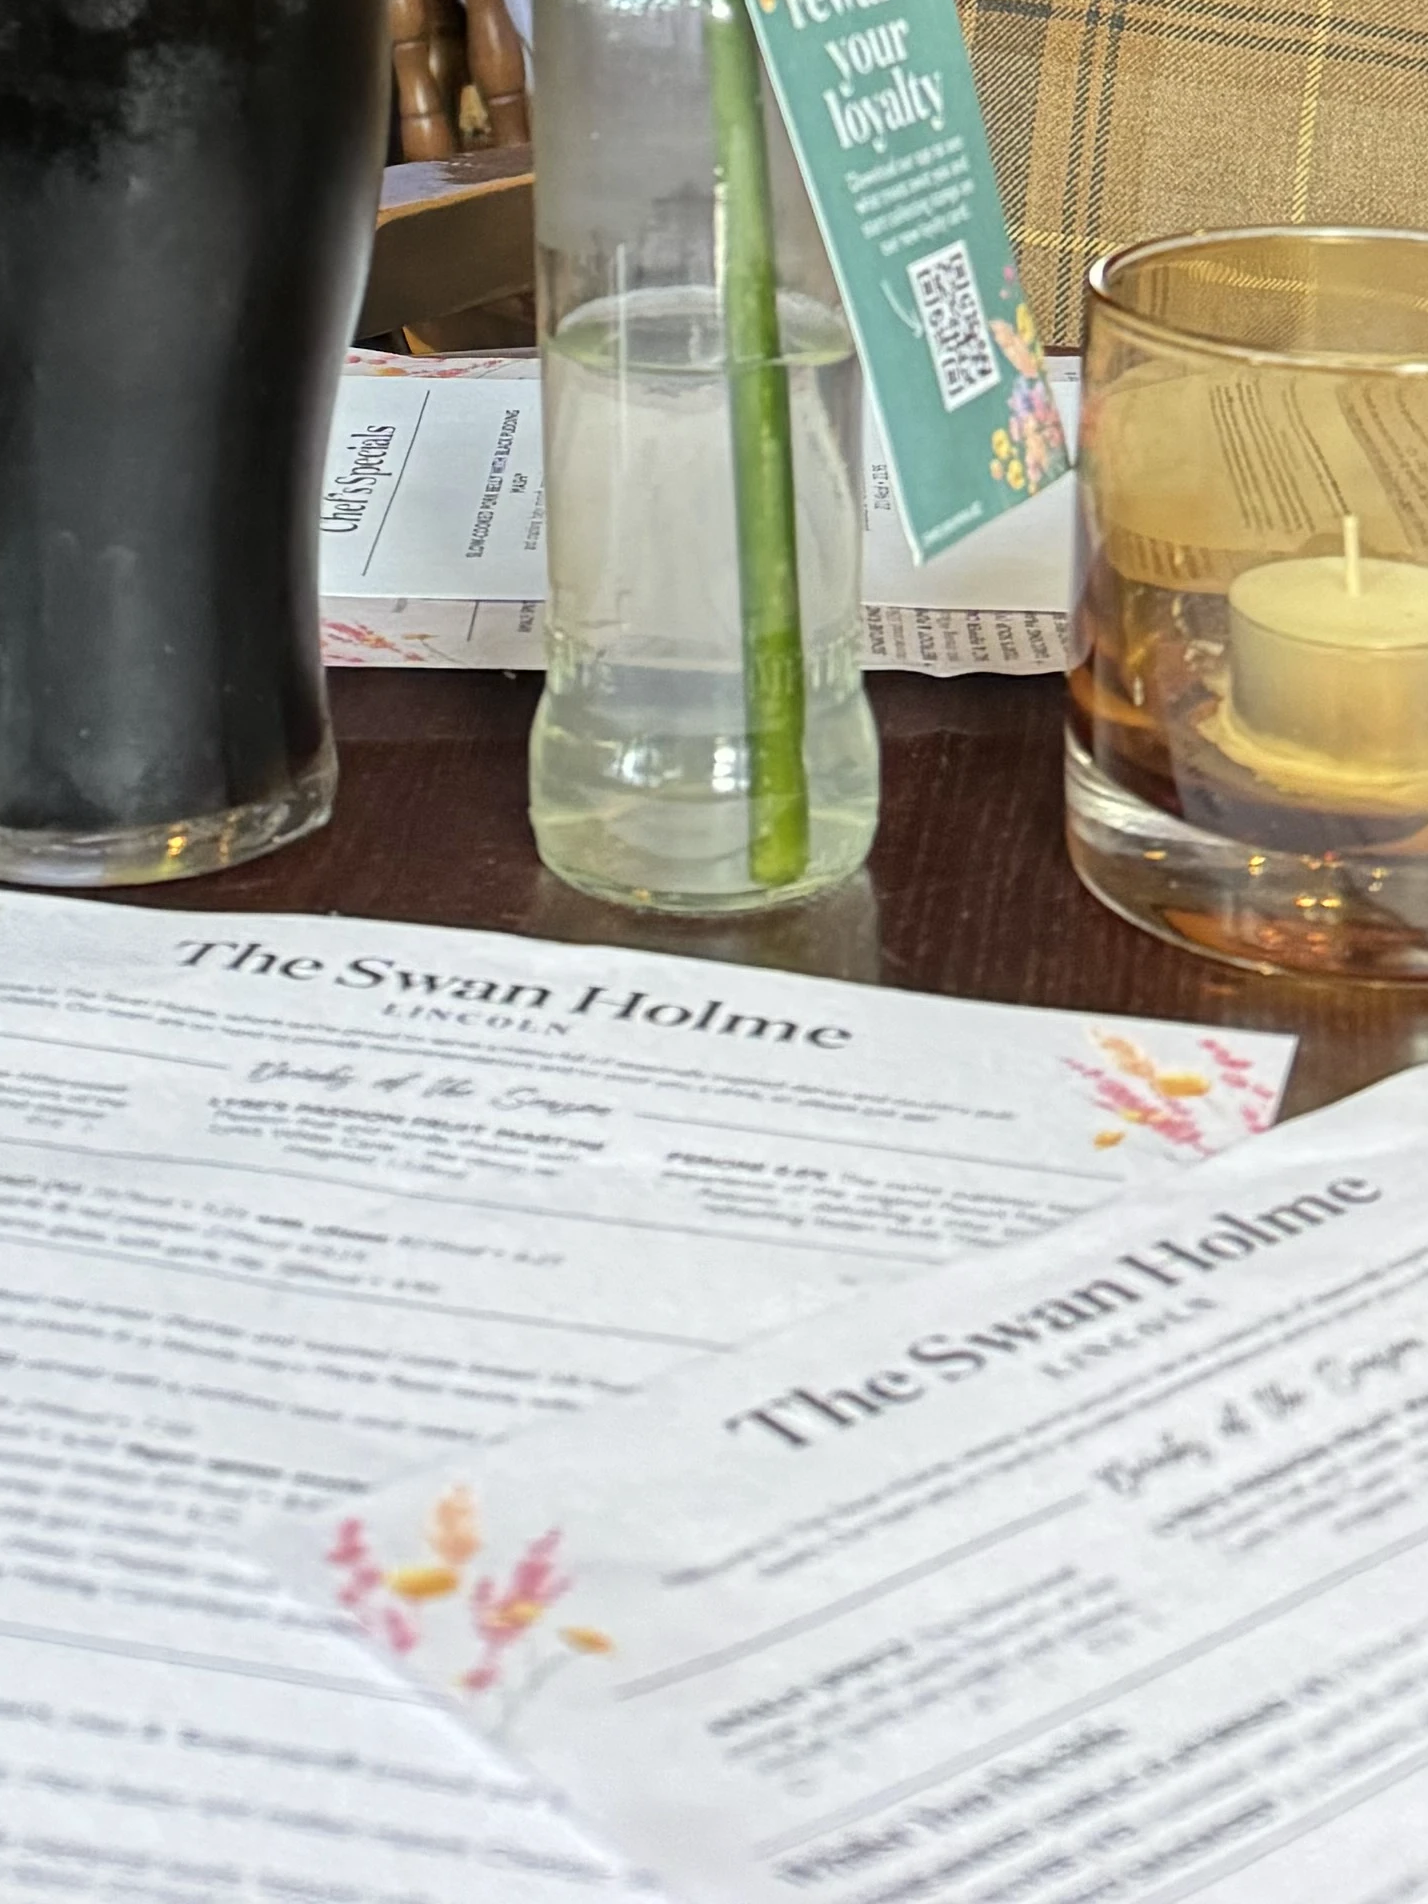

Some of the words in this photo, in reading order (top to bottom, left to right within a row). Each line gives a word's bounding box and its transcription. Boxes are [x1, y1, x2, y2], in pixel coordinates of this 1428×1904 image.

[824, 17, 911, 98] your
[824, 66, 946, 153] loyalty
[334, 424, 397, 485] Specials
[319, 486, 373, 534] Chef's
[174, 937, 323, 981] The
[332, 956, 553, 1011] Swan
[568, 985, 855, 1050] Holme
[379, 1001, 573, 1036] LINCOLN
[722, 1366, 928, 1452] The
[906, 1271, 1145, 1384] Swan
[1120, 1172, 1385, 1290] Holme
